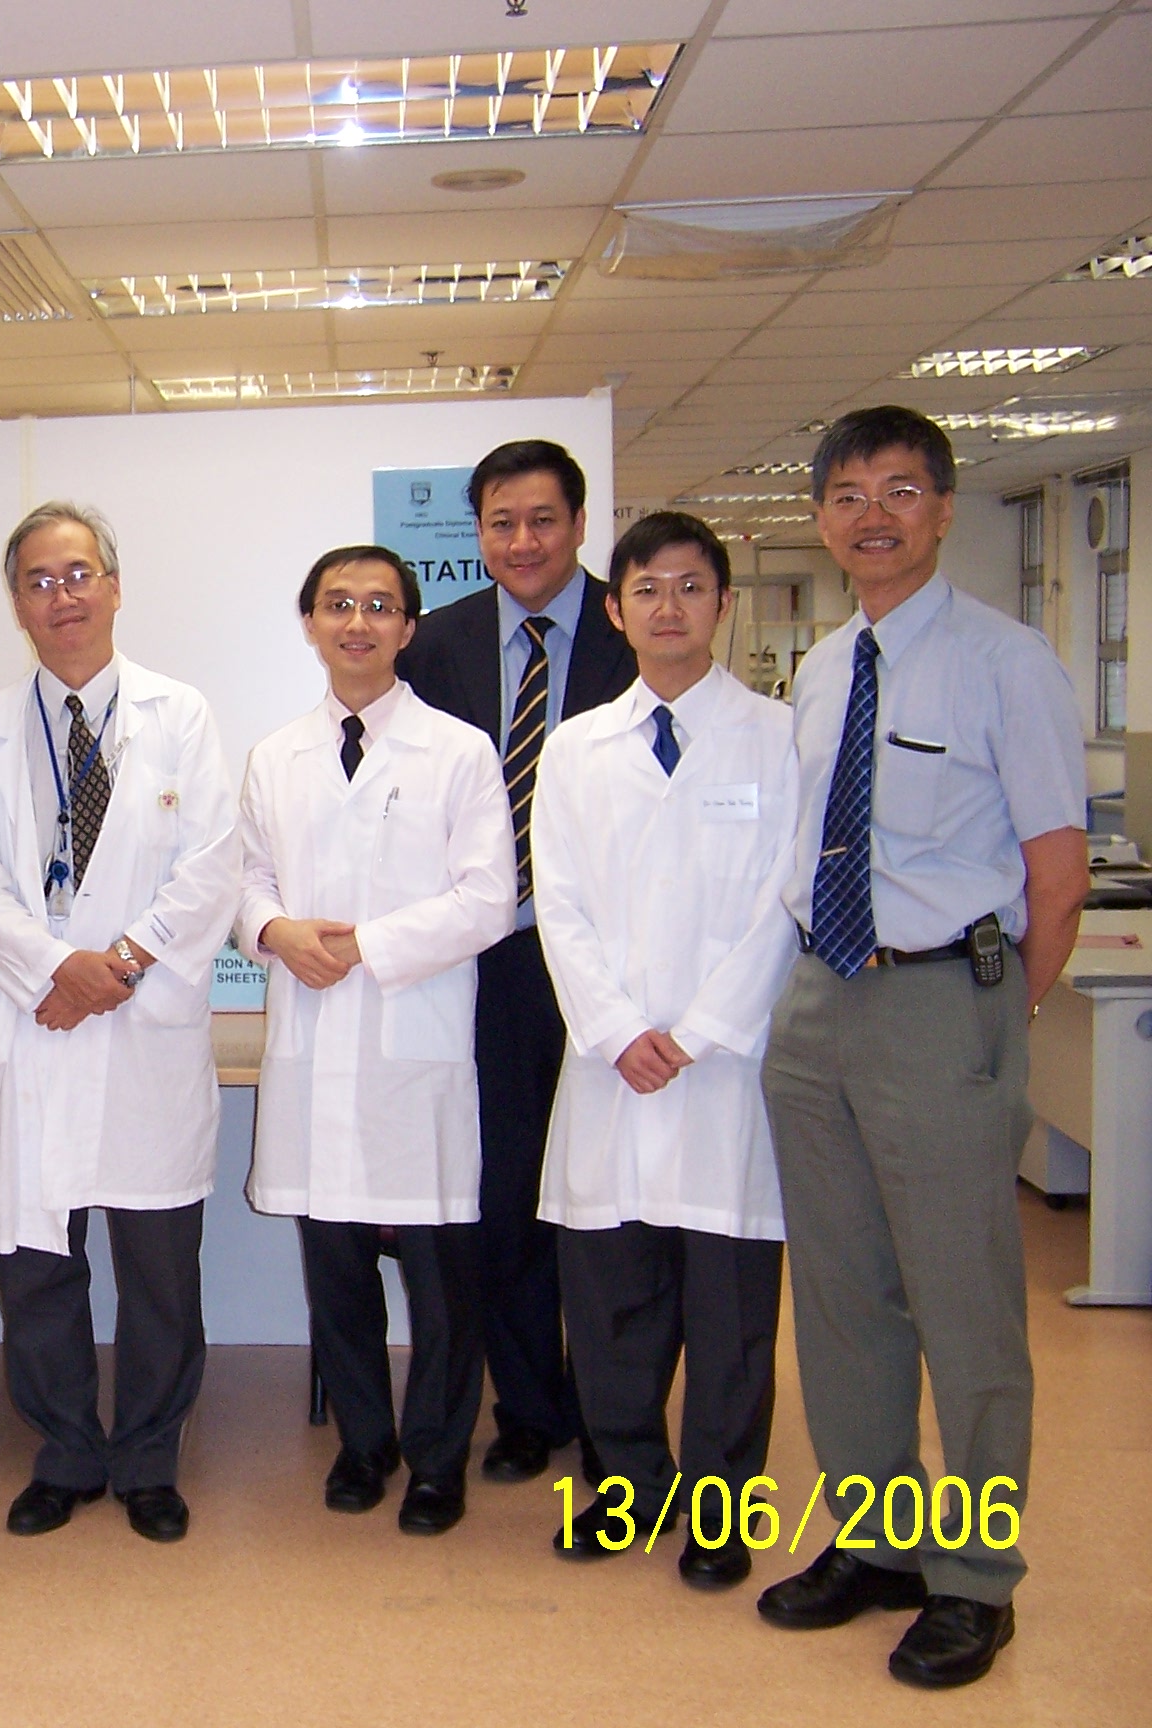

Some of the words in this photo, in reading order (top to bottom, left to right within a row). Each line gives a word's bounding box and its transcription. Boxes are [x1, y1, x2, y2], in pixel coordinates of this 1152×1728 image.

[613, 506, 633, 519] XIT
[213, 958, 244, 970] TION
[216, 972, 267, 984] SHEETS
